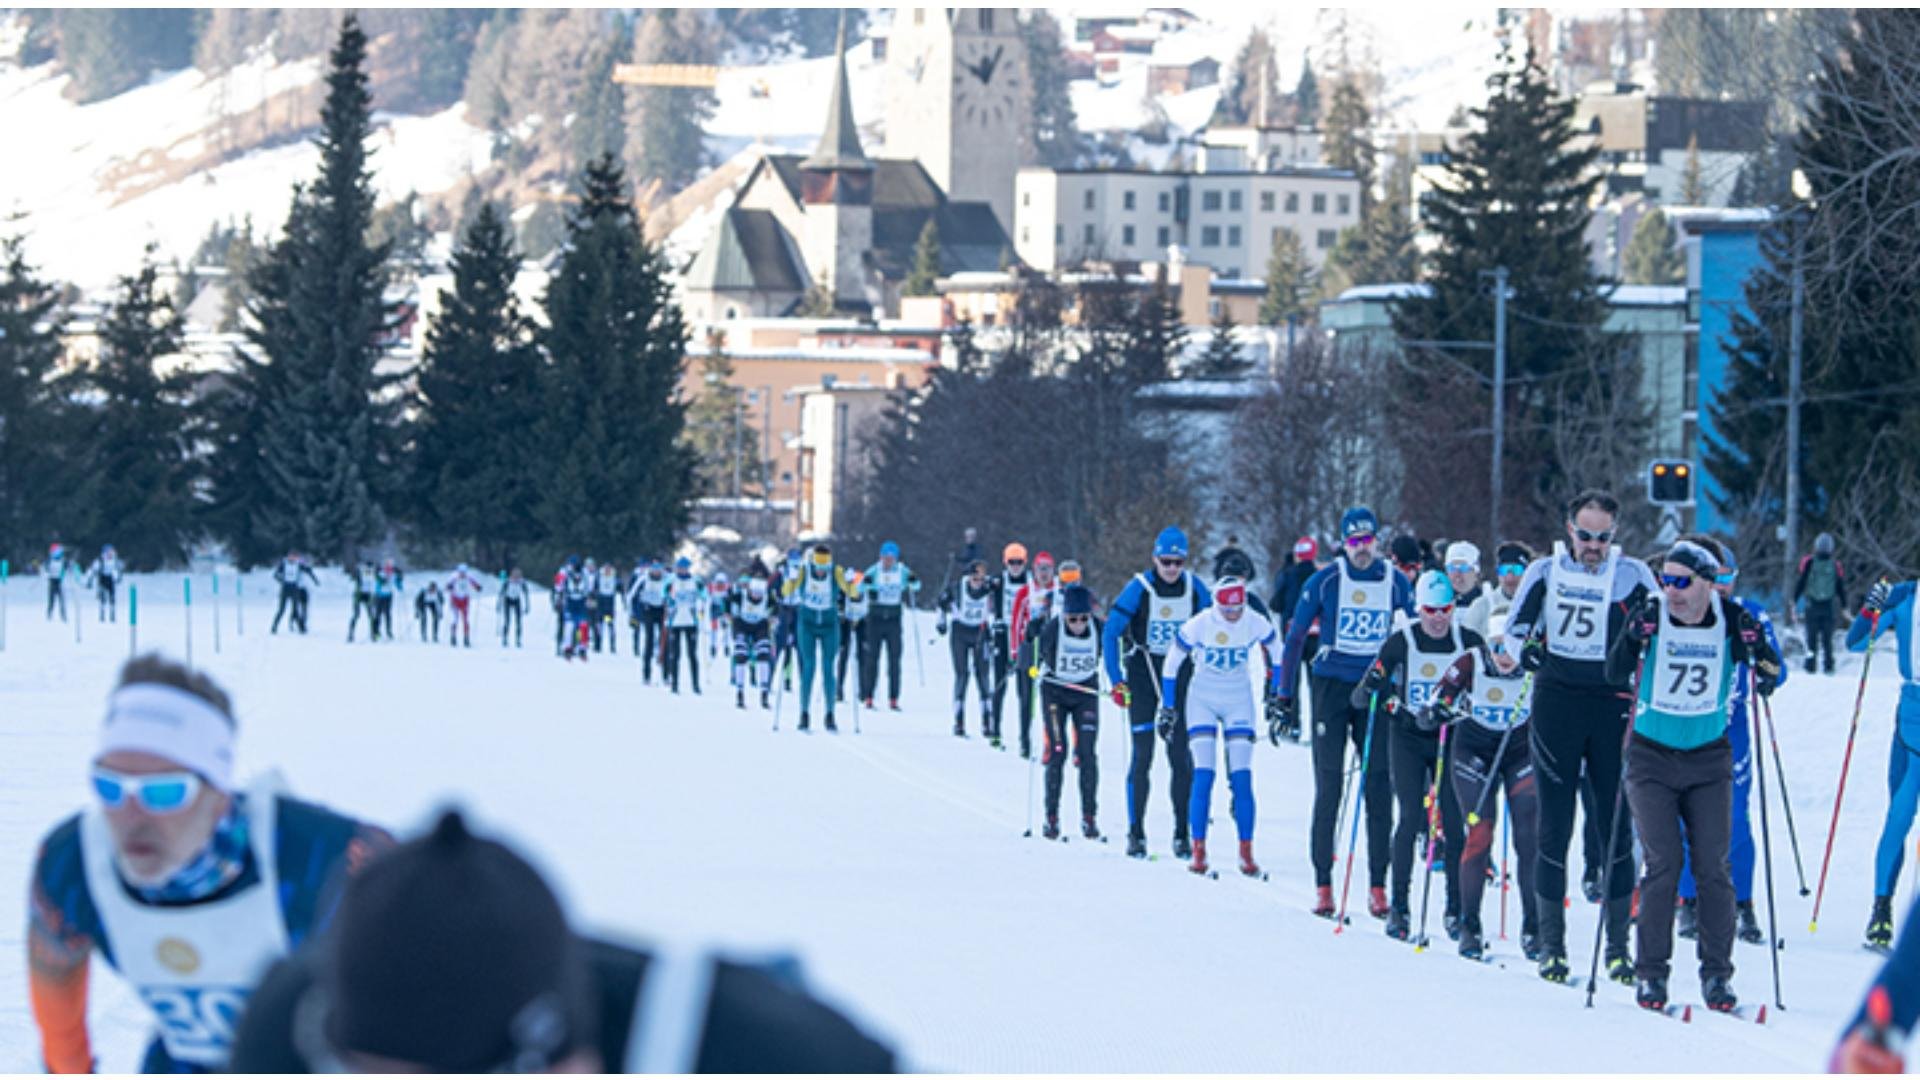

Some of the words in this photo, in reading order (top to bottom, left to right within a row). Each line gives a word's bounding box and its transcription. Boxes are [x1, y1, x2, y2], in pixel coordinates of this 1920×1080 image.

[1340, 611, 1387, 638] 284
[1557, 603, 1595, 638] 75
[1060, 656, 1096, 674] 158
[1668, 663, 1709, 696] 73
